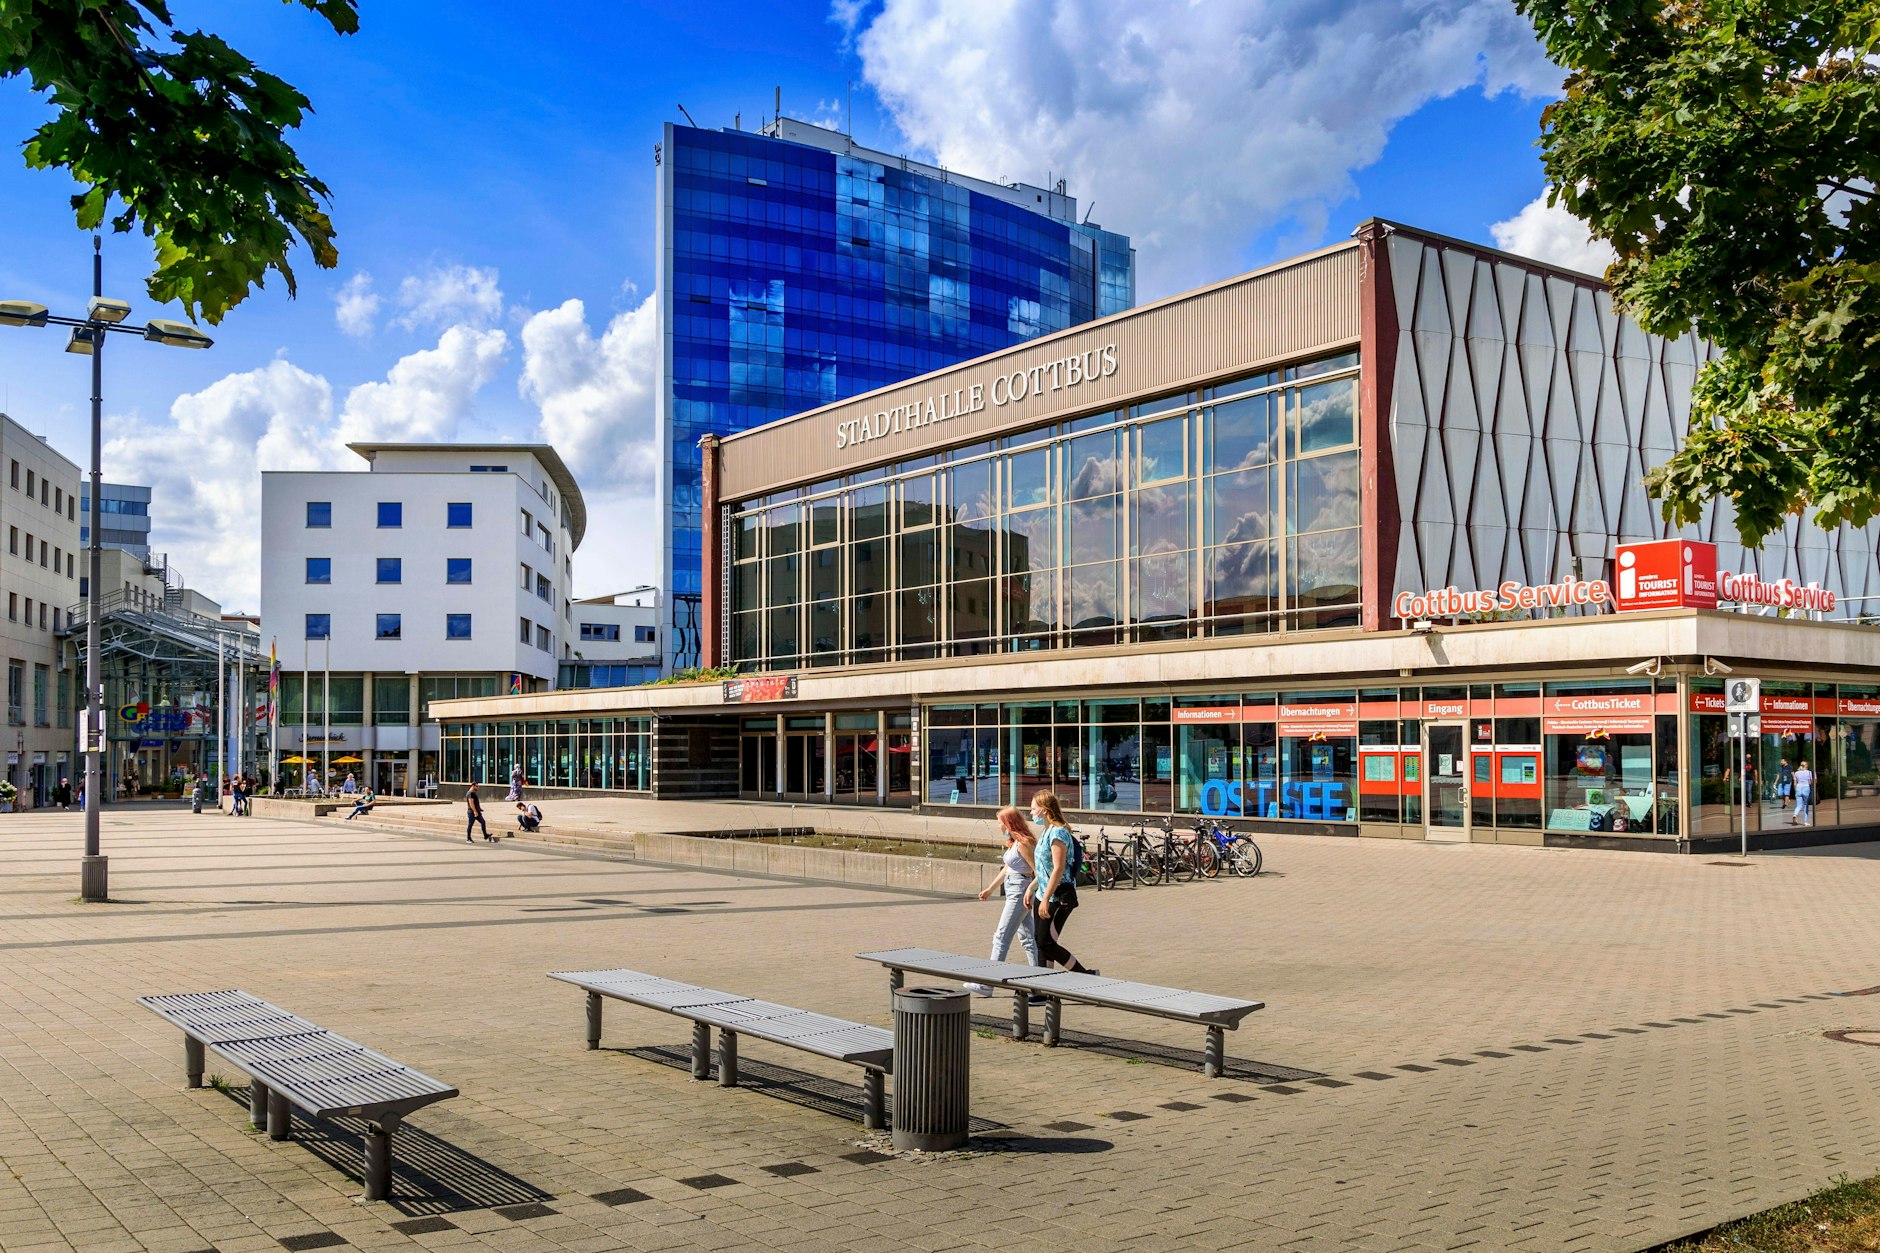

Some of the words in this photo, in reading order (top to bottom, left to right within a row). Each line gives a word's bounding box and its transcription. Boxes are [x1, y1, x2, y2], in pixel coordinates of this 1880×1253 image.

[837, 383, 985, 448] STADTHALLE
[991, 343, 1118, 405] COTTBUS
[1638, 579, 1678, 590] TOURIST
[1694, 580, 1715, 590] TOURIST
[1395, 586, 1495, 618] Cottbus
[1499, 575, 1607, 610] Service
[1638, 589, 1678, 598] INFORMATION
[1721, 571, 1781, 606] Cottbus
[1784, 579, 1836, 612] Service
[1428, 703, 1463, 715] Eingang
[1773, 700, 1809, 711] Informationen
[1177, 710, 1222, 719] Informationen
[1281, 706, 1340, 717] Übernachtungen
